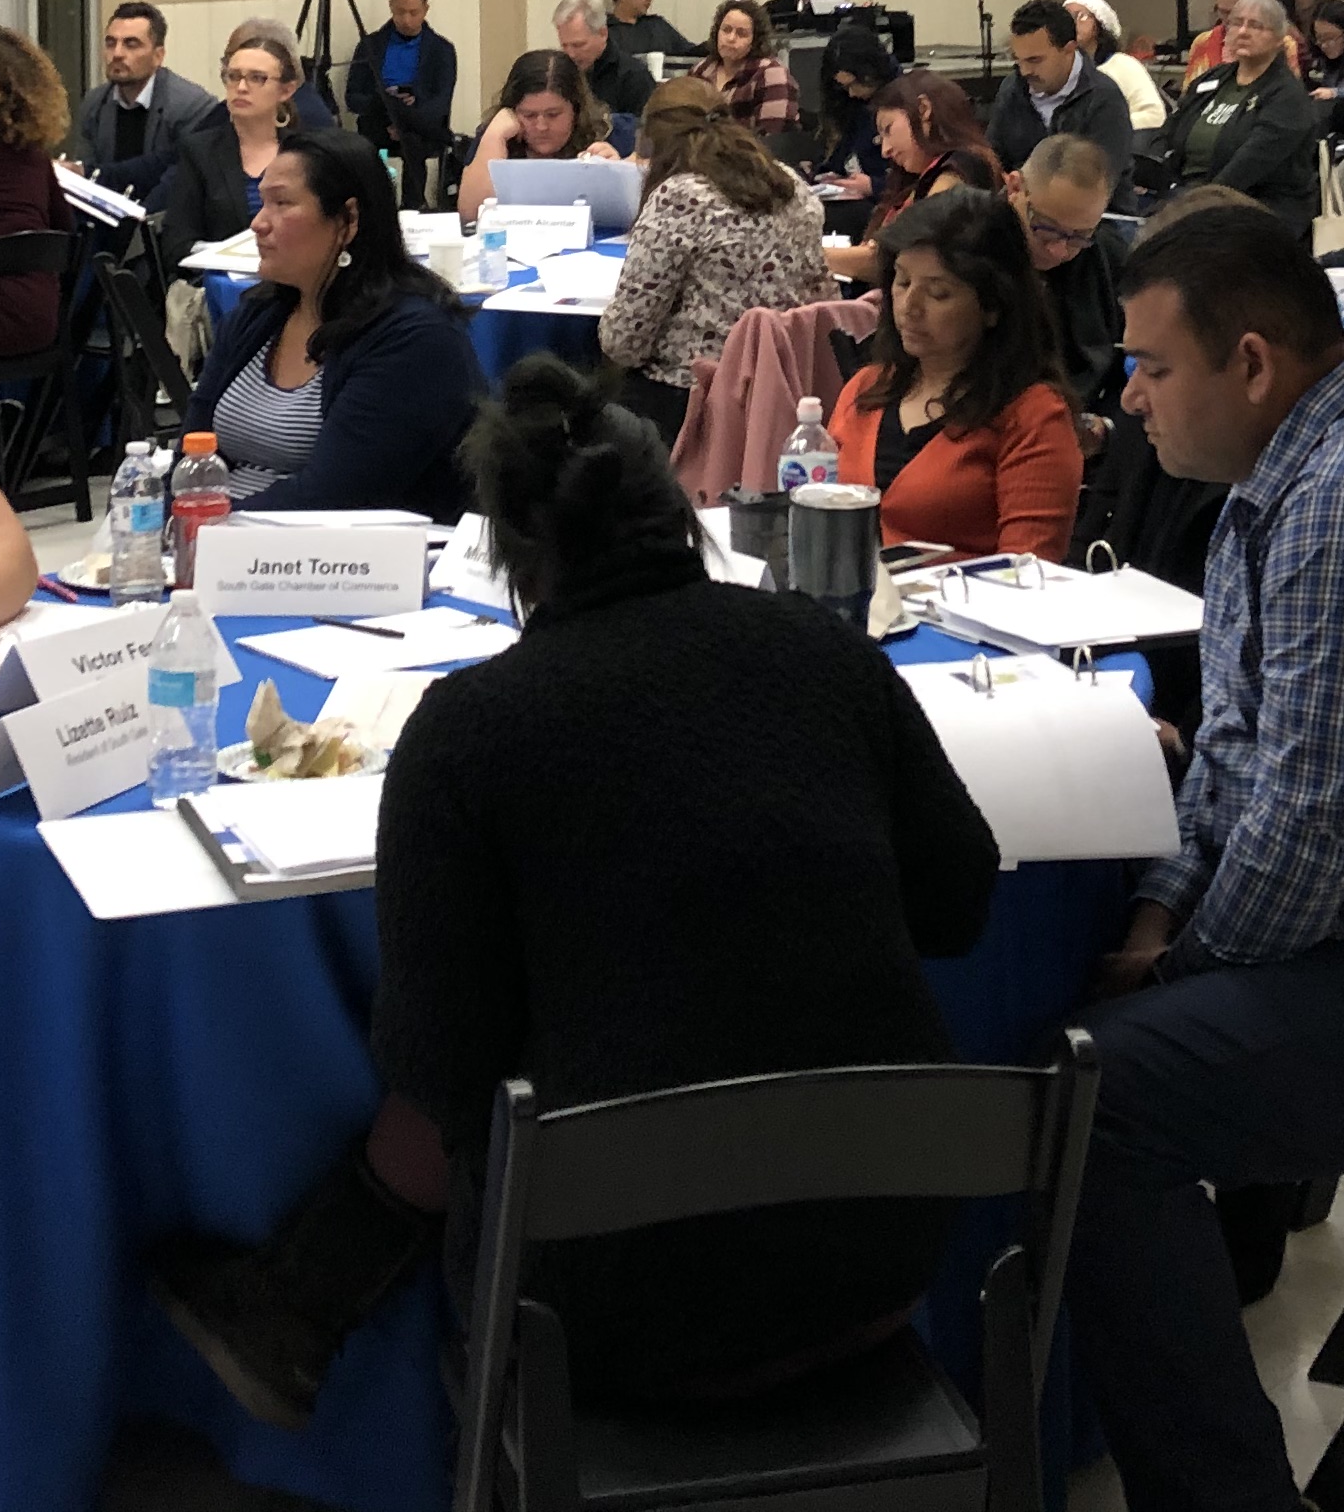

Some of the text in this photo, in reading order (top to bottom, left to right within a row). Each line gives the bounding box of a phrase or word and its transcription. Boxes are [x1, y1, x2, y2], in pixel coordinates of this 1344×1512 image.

[247, 557, 370, 576] Janet Torres
[217, 580, 247, 592] South
[250, 580, 275, 592] Gate
[278, 580, 326, 593] Chamber
[342, 580, 400, 593] Commerce
[71, 648, 124, 675] Victor
[56, 701, 140, 748] Lizette Ruiz
